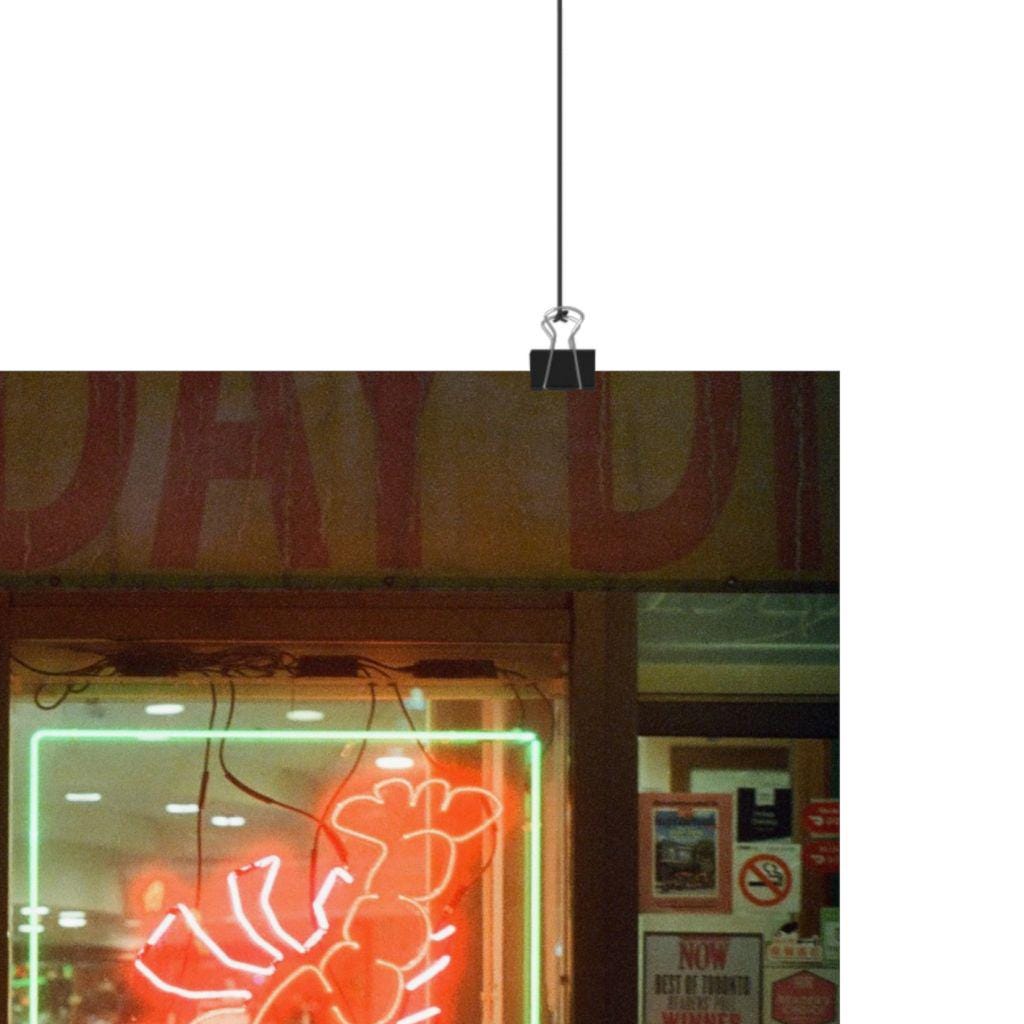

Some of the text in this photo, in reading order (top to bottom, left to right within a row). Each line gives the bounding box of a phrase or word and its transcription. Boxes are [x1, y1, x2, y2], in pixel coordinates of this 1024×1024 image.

[678, 941, 728, 970] NOW
[654, 974, 751, 996] BEST OF TORONTO
